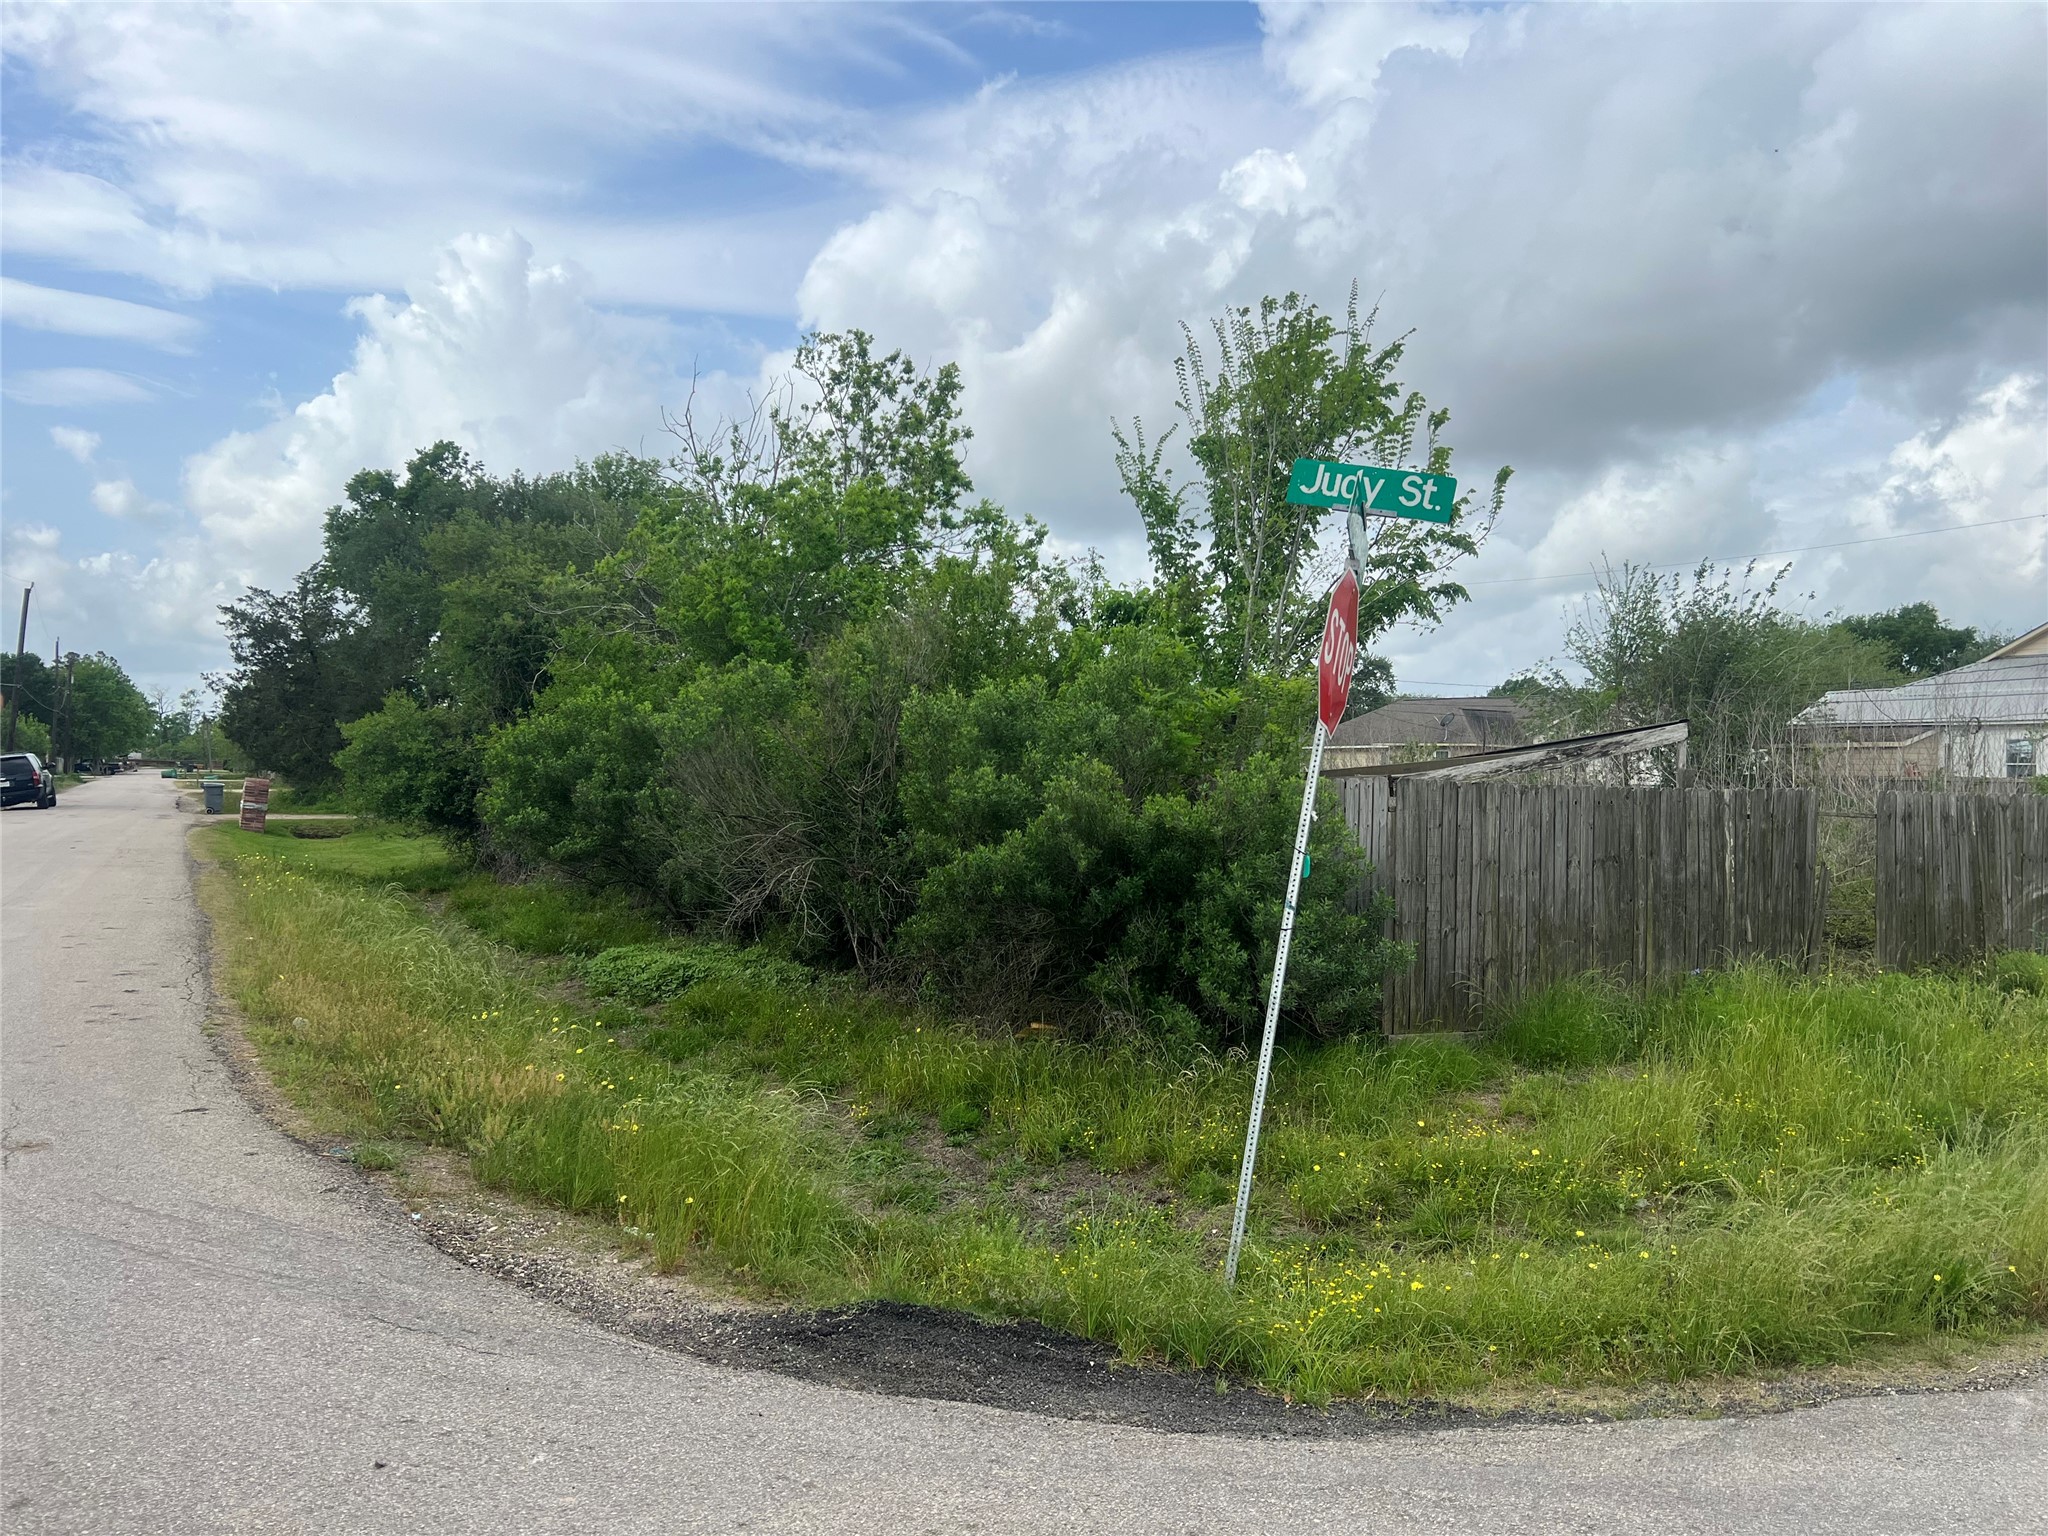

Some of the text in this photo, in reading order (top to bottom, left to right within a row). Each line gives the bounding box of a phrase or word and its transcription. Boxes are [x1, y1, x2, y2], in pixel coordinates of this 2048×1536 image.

[1300, 464, 1441, 511] Judy St.
[1324, 608, 1355, 694] STOP
